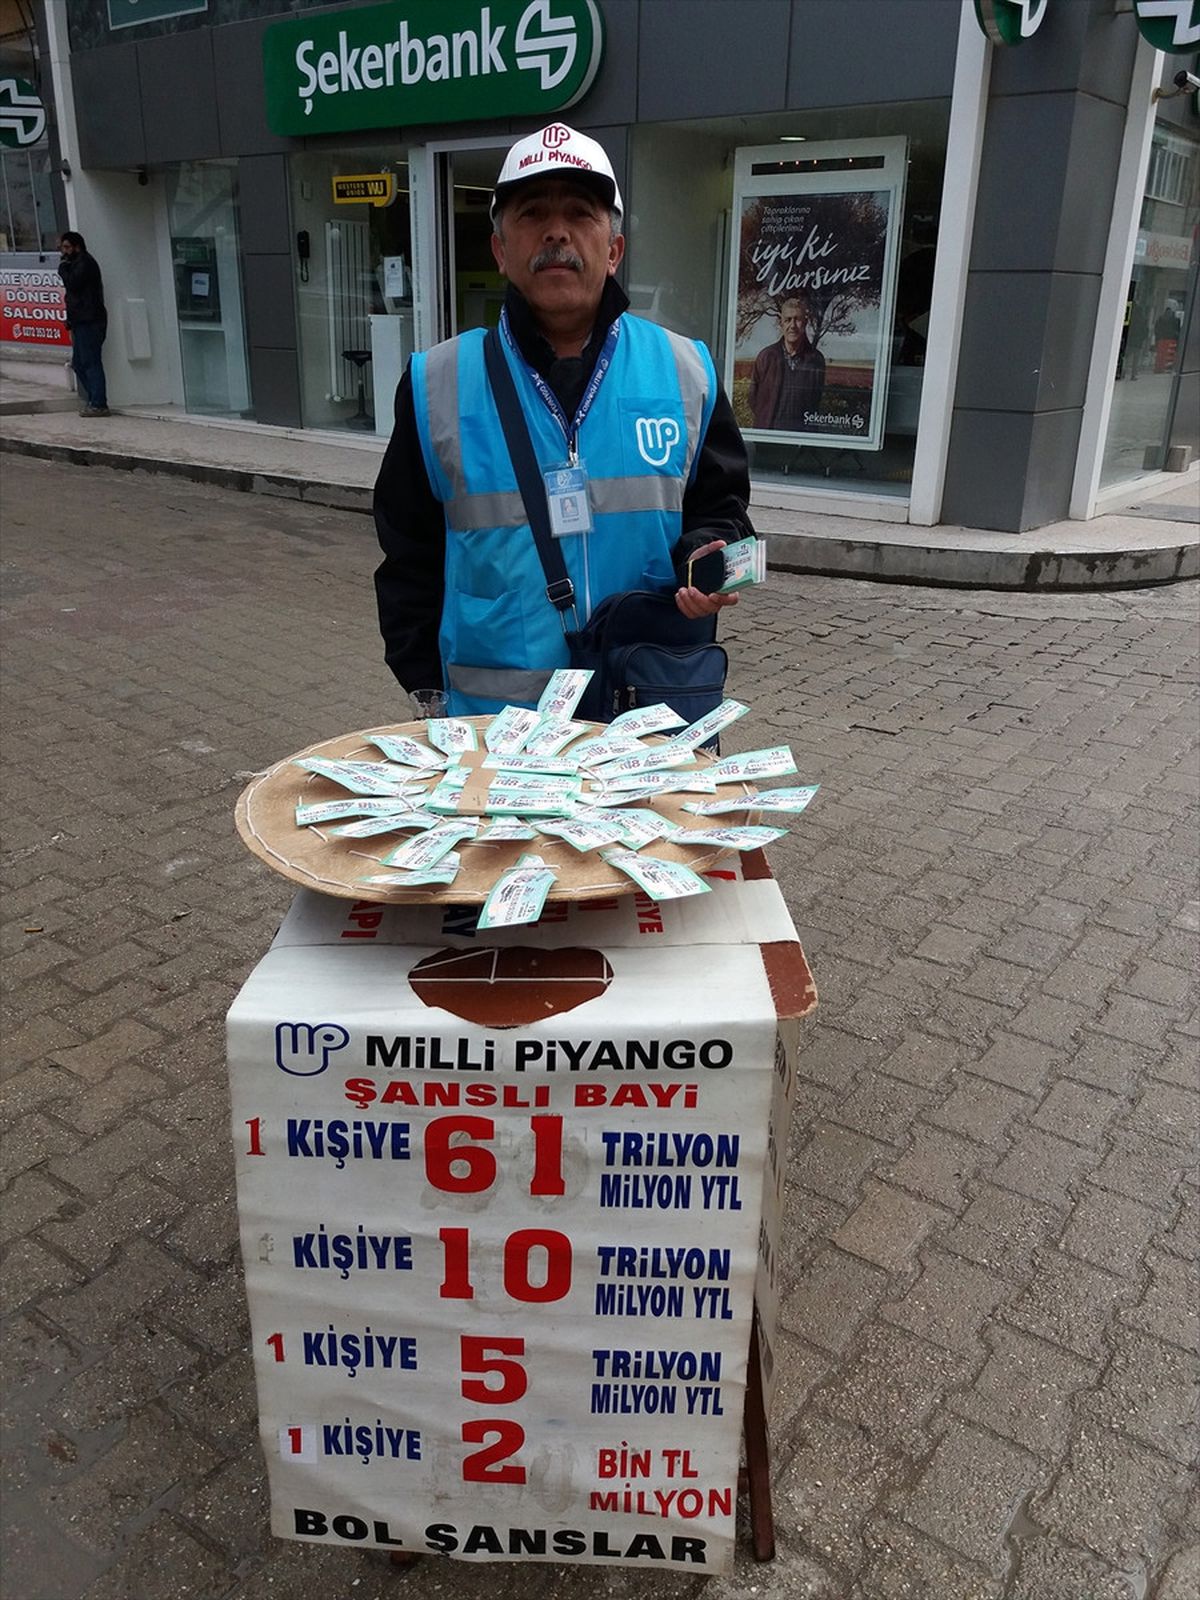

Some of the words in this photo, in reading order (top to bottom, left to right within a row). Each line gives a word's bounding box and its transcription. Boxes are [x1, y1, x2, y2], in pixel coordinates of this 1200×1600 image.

[295, 7, 507, 116] Şekerbank
[0, 272, 64, 287] MEYDAN
[6, 288, 61, 303] DÖNER
[3, 306, 67, 321] SALONU
[803, 411, 851, 425] Şekerbank
[345, 1078, 550, 1108] ŞANSLI
[246, 1118, 266, 1156] 1
[701, 1176, 742, 1210] YTL
[439, 1228, 572, 1303] 10
[693, 1287, 733, 1319] YTL
[267, 1333, 285, 1362] 1
[461, 1335, 528, 1404] 5
[686, 1386, 724, 1416] YTL
[288, 1428, 302, 1454] 1
[461, 1419, 527, 1484] 2
[598, 1441, 652, 1479] BİN
[662, 1449, 699, 1479] TL
[294, 1509, 402, 1546] BOL
[425, 1523, 707, 1564] ŞANSLAR
